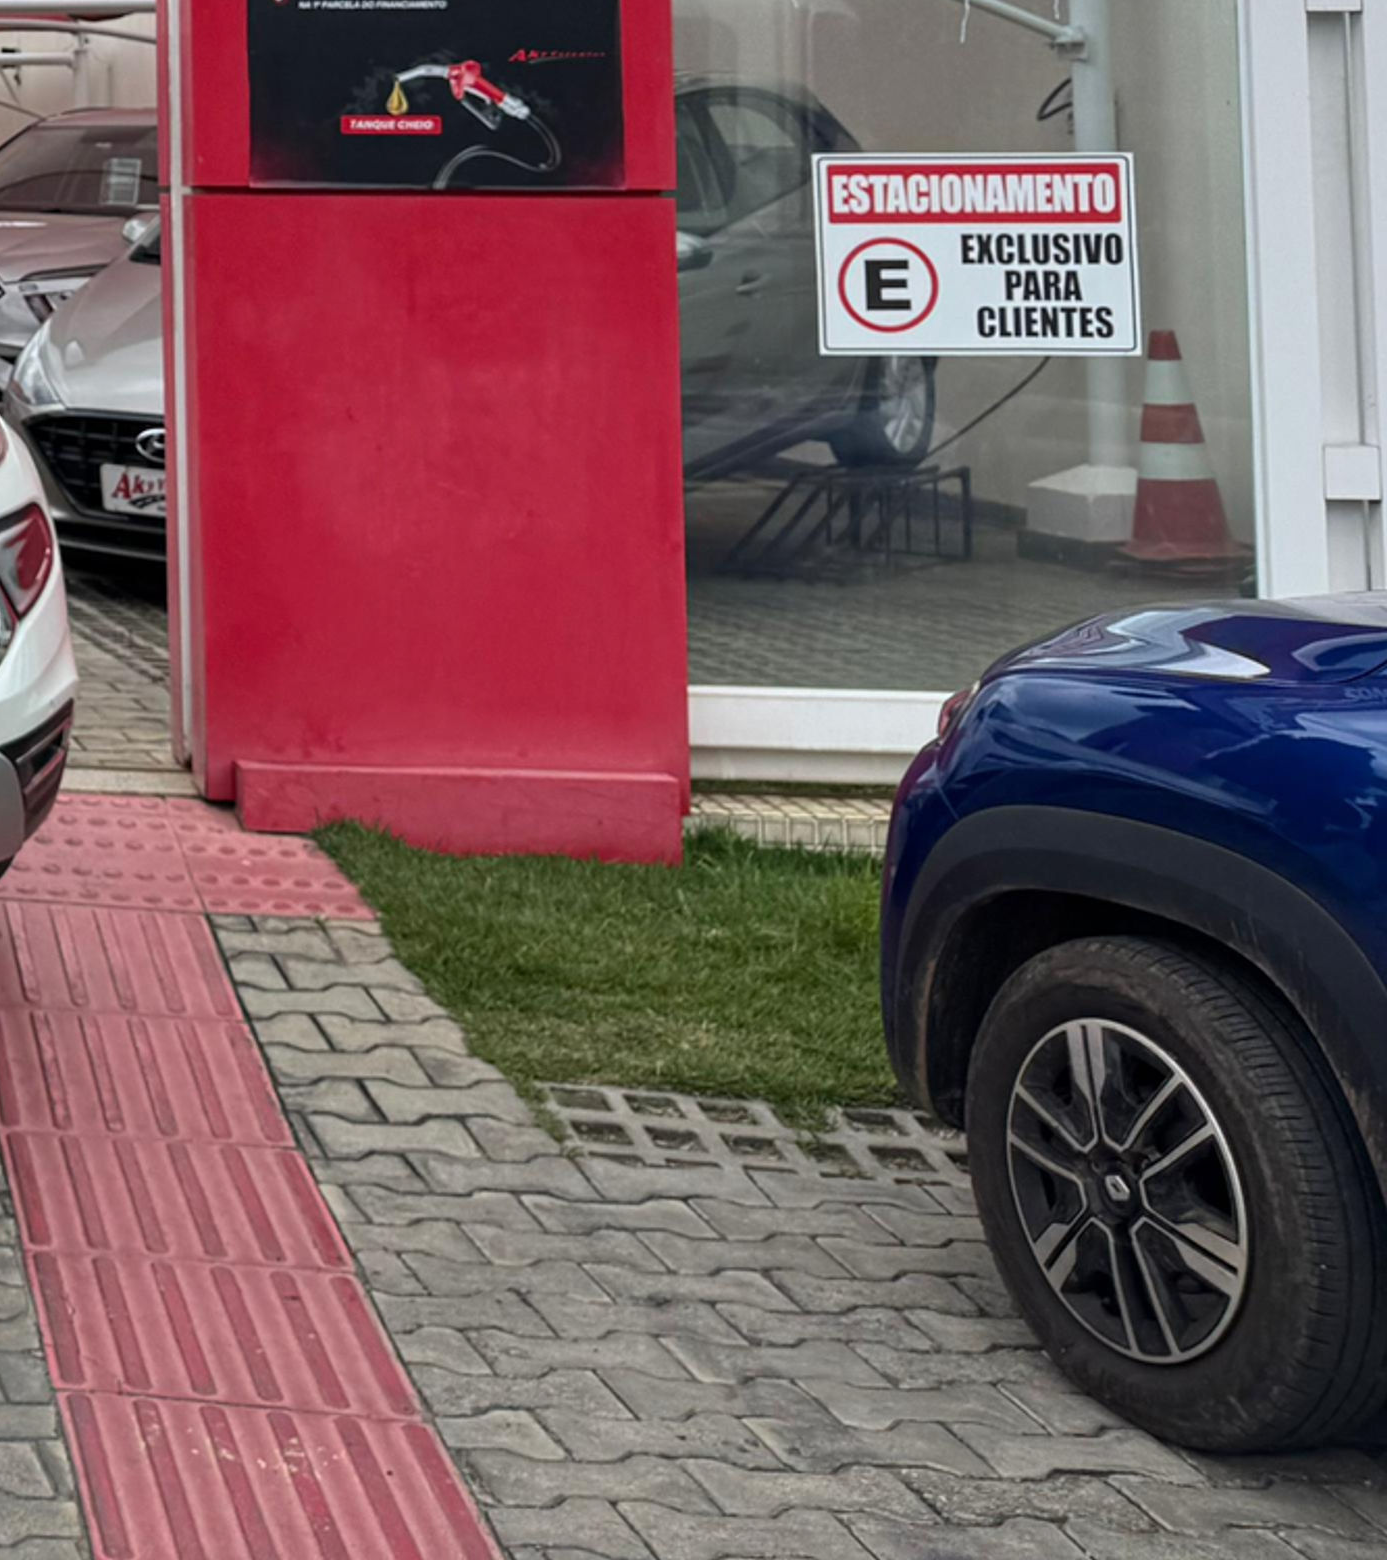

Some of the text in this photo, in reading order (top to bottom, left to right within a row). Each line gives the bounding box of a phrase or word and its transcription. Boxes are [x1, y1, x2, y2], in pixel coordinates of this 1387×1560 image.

[350, 119, 434, 131] TANQUE CHEIO
[830, 172, 1116, 215] ESTACIONAMENTO
[960, 233, 1124, 266] EXCLUSIVO
[864, 260, 913, 312] E
[1004, 271, 1083, 302] PARA
[976, 306, 1115, 339] CLIENTES
